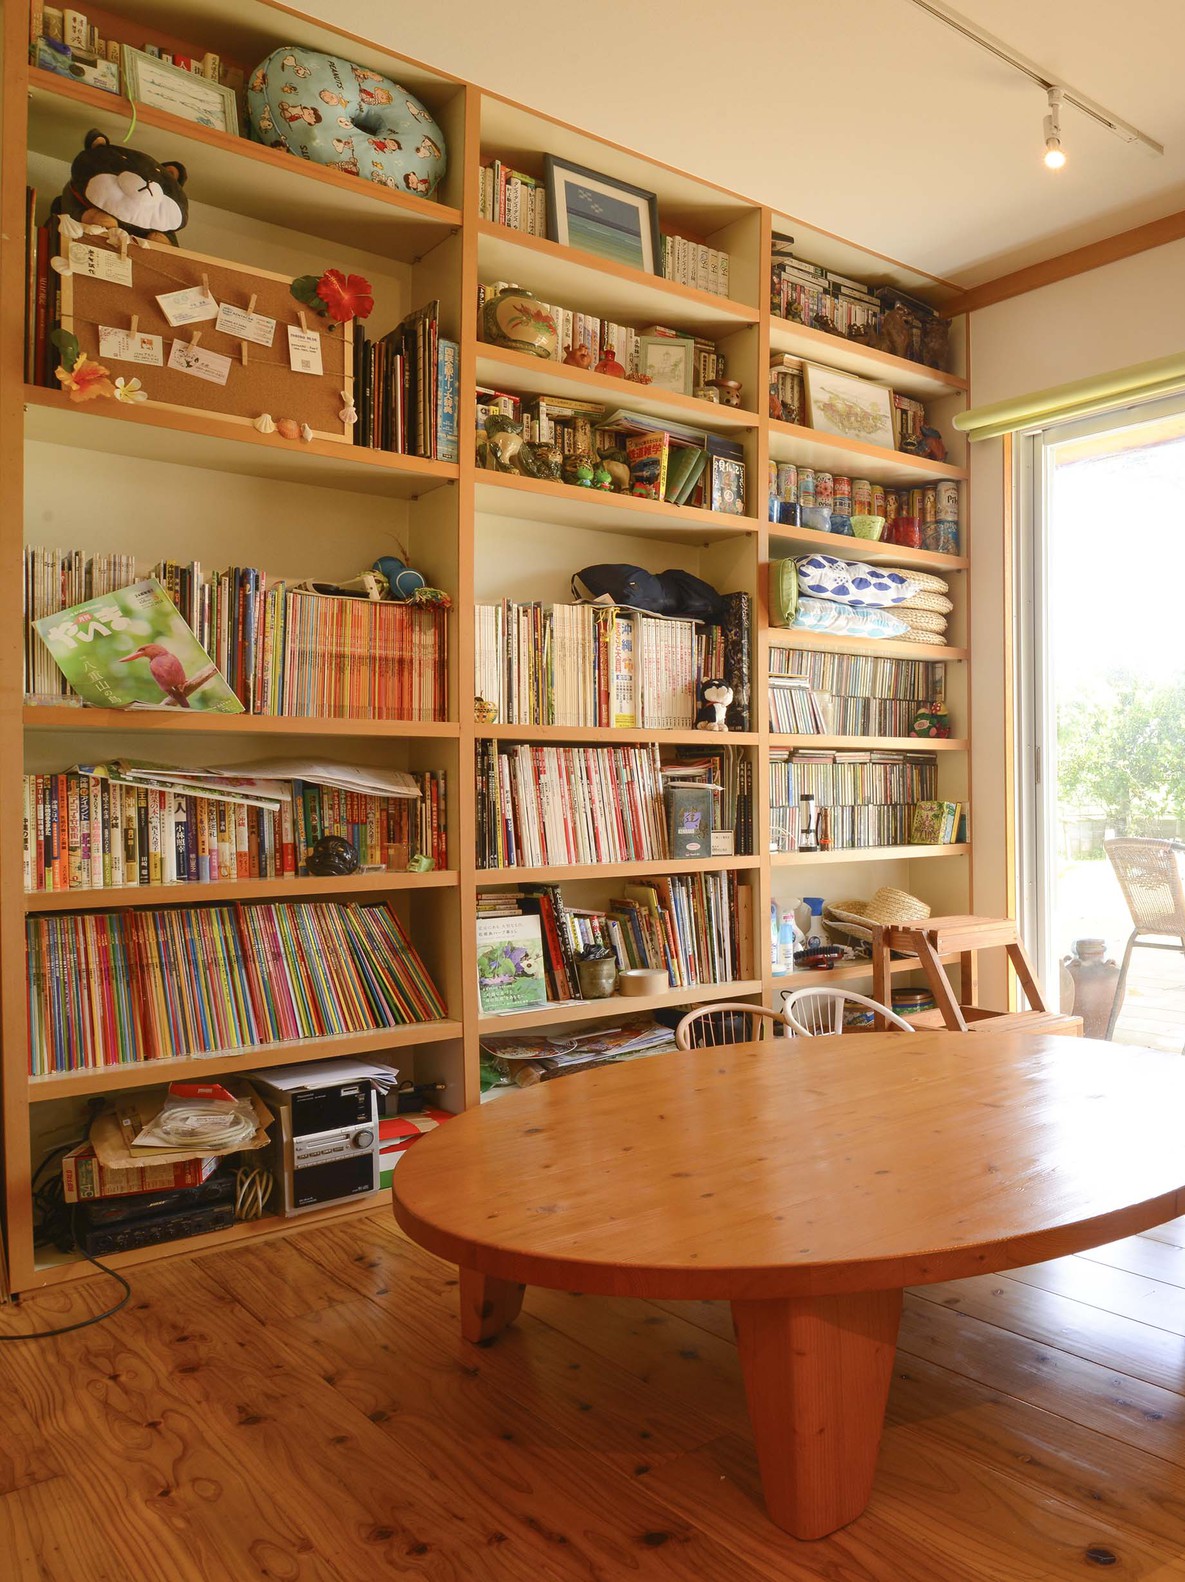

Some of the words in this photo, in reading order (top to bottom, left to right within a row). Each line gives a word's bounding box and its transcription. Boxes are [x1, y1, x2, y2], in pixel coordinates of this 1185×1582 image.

[327, 60, 344, 91] PEANUTS
[700, 249, 709, 270] 1Q84
[720, 257, 728, 277] 1Q84
[621, 622, 633, 653] 沖縄
[66, 1169, 75, 1193] BUFFALO
